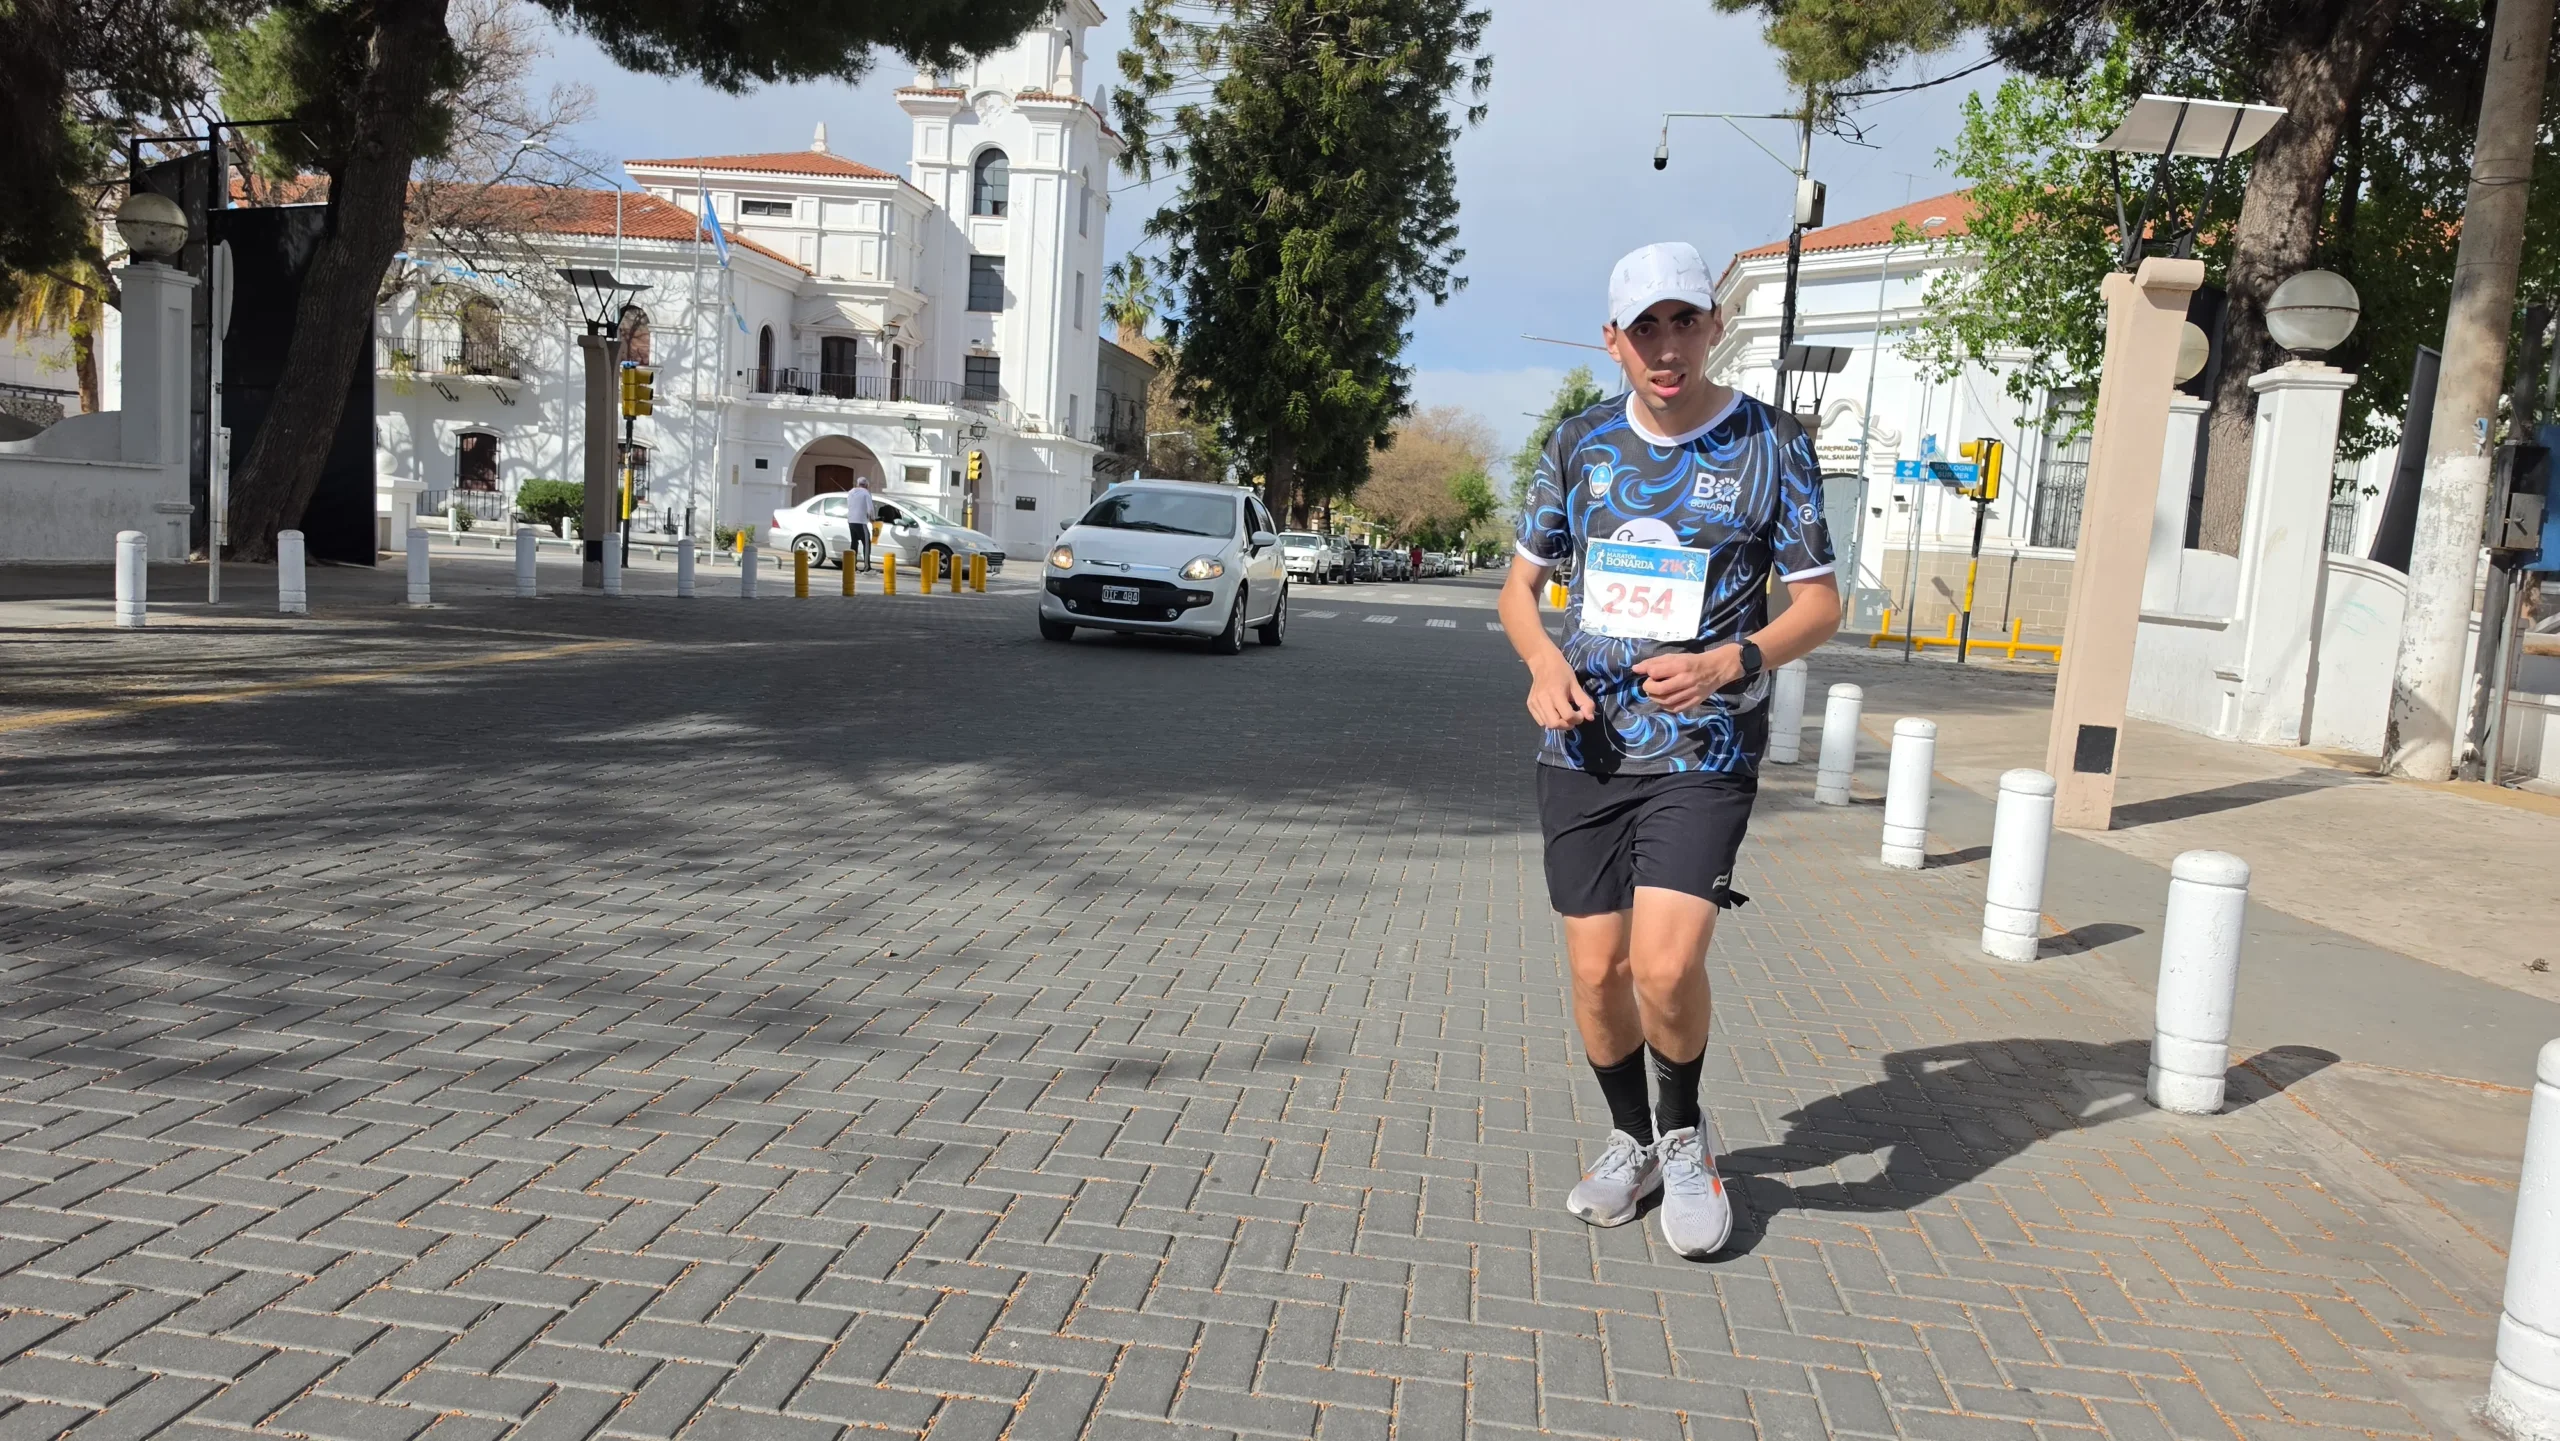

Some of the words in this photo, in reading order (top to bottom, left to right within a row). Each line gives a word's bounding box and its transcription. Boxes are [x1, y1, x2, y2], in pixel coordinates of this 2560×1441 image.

[1934, 464, 1975, 473] BOULOGNE
[1690, 498, 1736, 515] BONARDA
[1606, 552, 1637, 560] MARATÓN
[1606, 557, 1655, 570] BONARDA
[1659, 558, 1687, 574] 21K
[1601, 582, 1674, 620] 254
